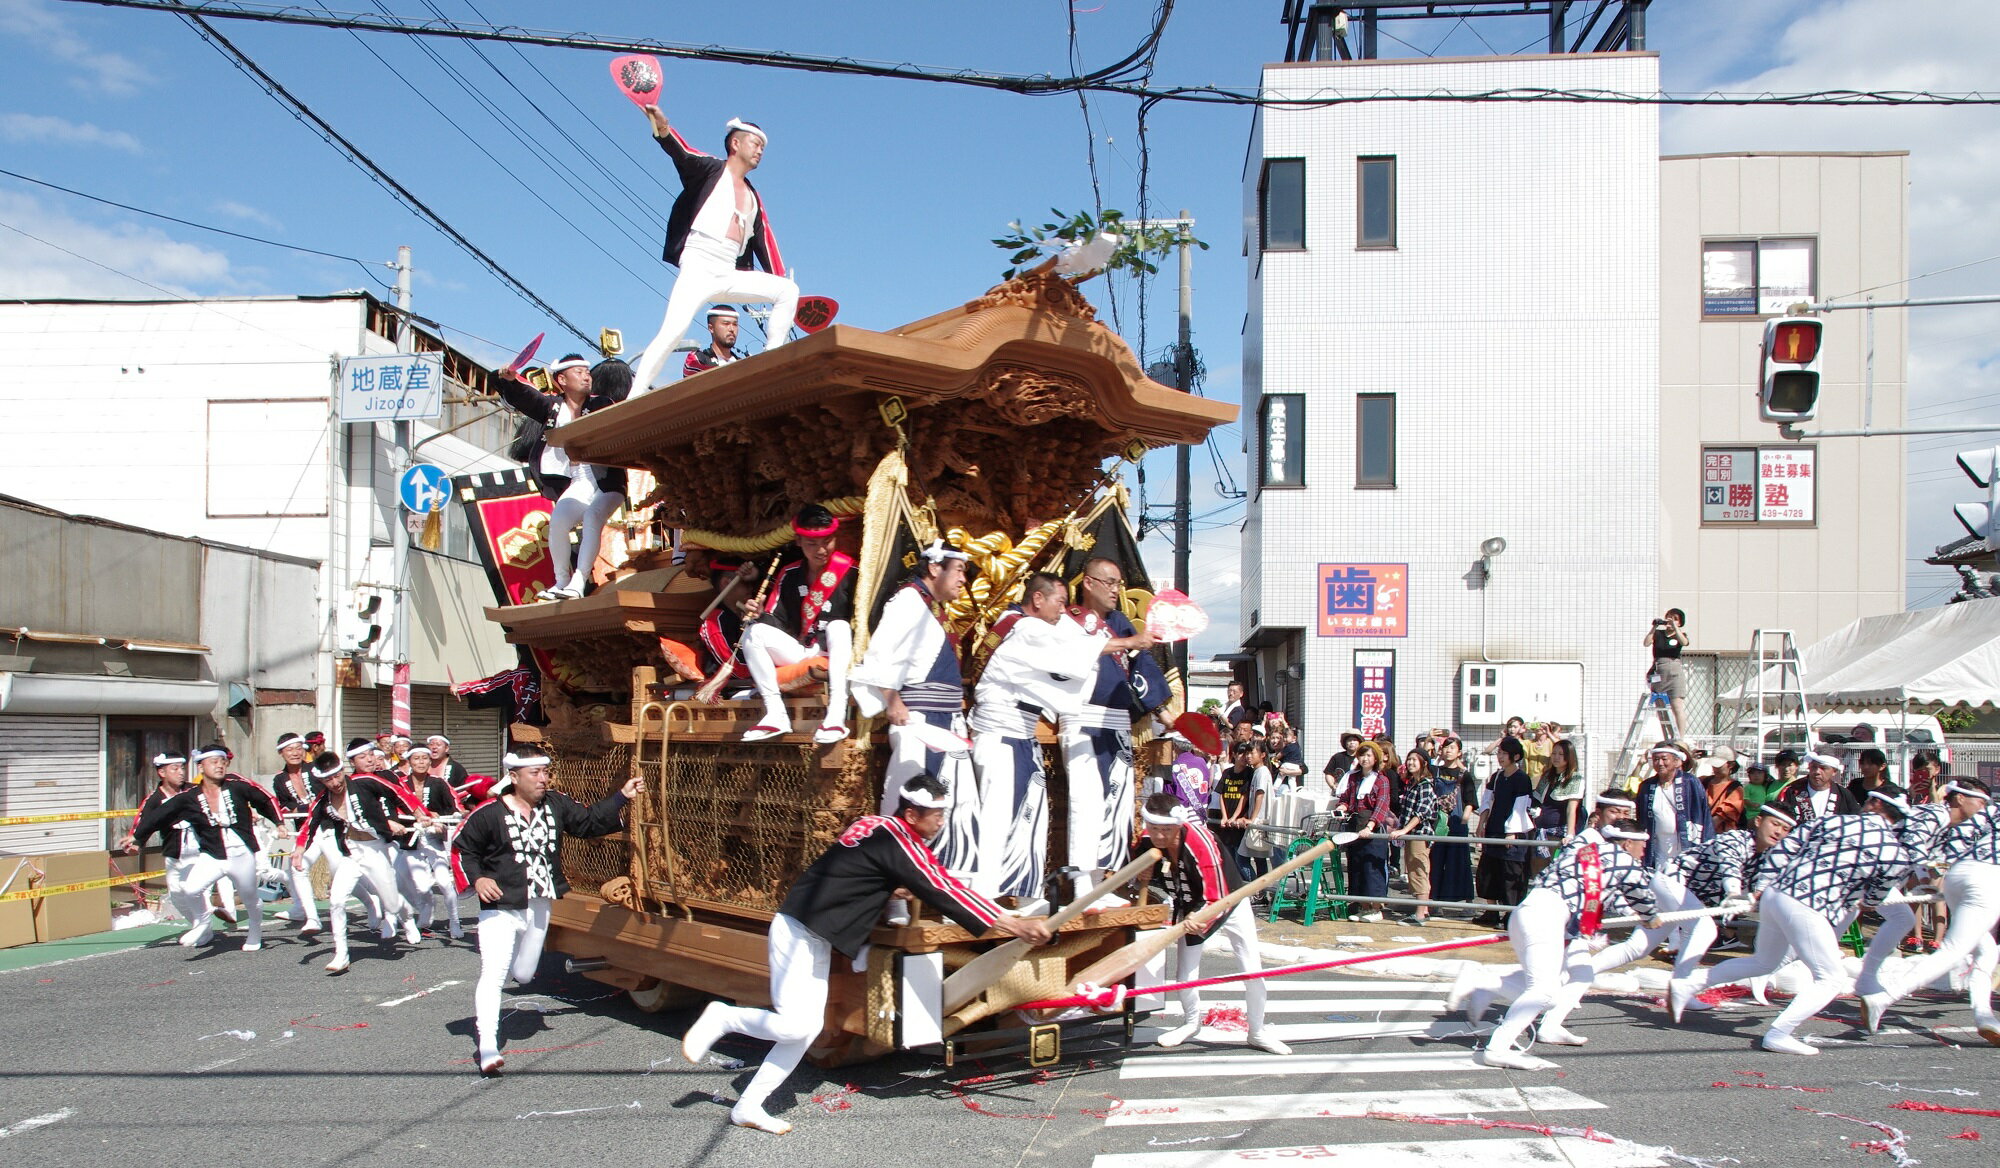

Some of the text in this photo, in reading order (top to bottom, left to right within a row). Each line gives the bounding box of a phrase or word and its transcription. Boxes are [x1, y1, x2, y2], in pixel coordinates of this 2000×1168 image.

[351, 363, 431, 391] 地蔵堂
[365, 396, 415, 411] Jizodo
[1707, 456, 1731, 467] 完全
[1707, 469, 1731, 480] 個別
[1761, 463, 1811, 478] 塾生募集
[1728, 484, 1789, 507] 勝 塾
[1762, 509, 1803, 518] 439-4729
[1325, 567, 1377, 615] 歯
[1328, 616, 1397, 627] いなば歯科
[1362, 693, 1385, 738] 勝塾
